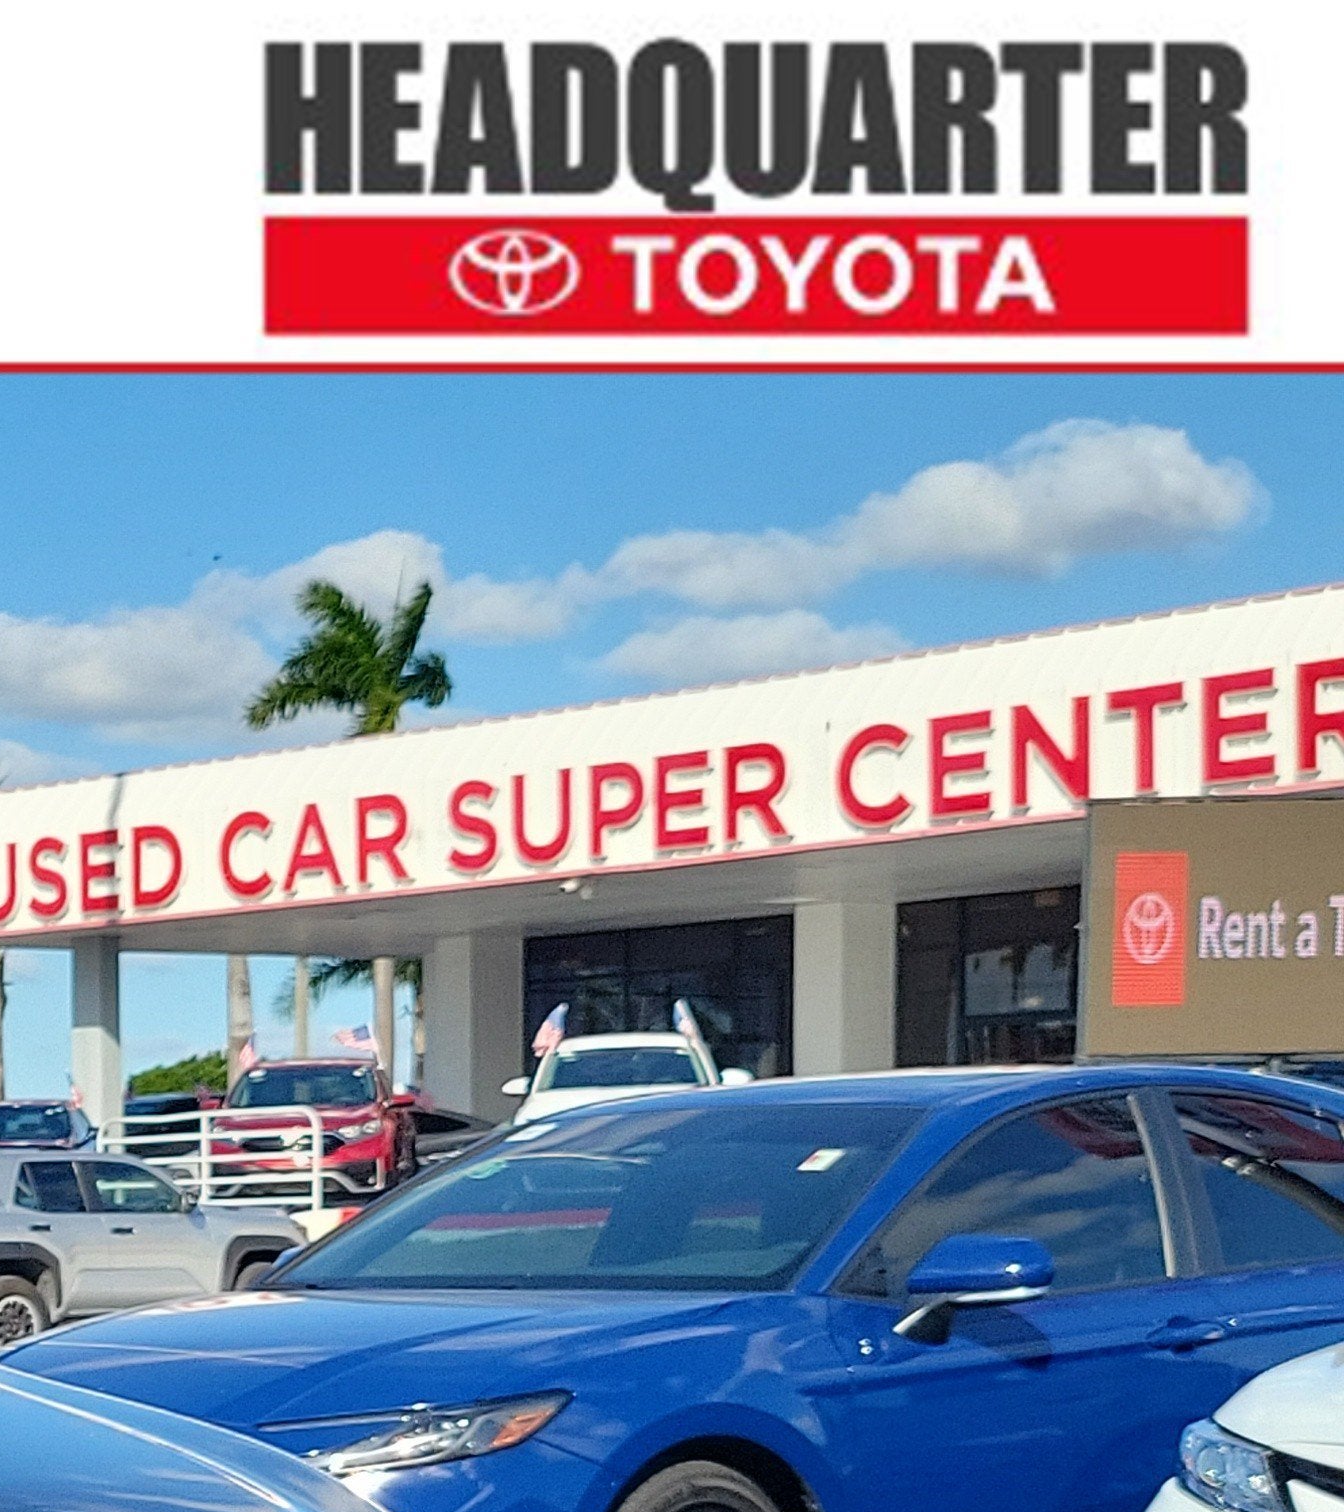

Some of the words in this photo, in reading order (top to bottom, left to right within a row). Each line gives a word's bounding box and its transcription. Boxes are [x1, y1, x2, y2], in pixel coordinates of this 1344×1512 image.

[221, 794, 408, 897] CAR
[450, 742, 786, 871] SUPER
[837, 656, 1344, 825] CENTER
[1198, 896, 1286, 960] Rent
[1295, 911, 1319, 958] a
